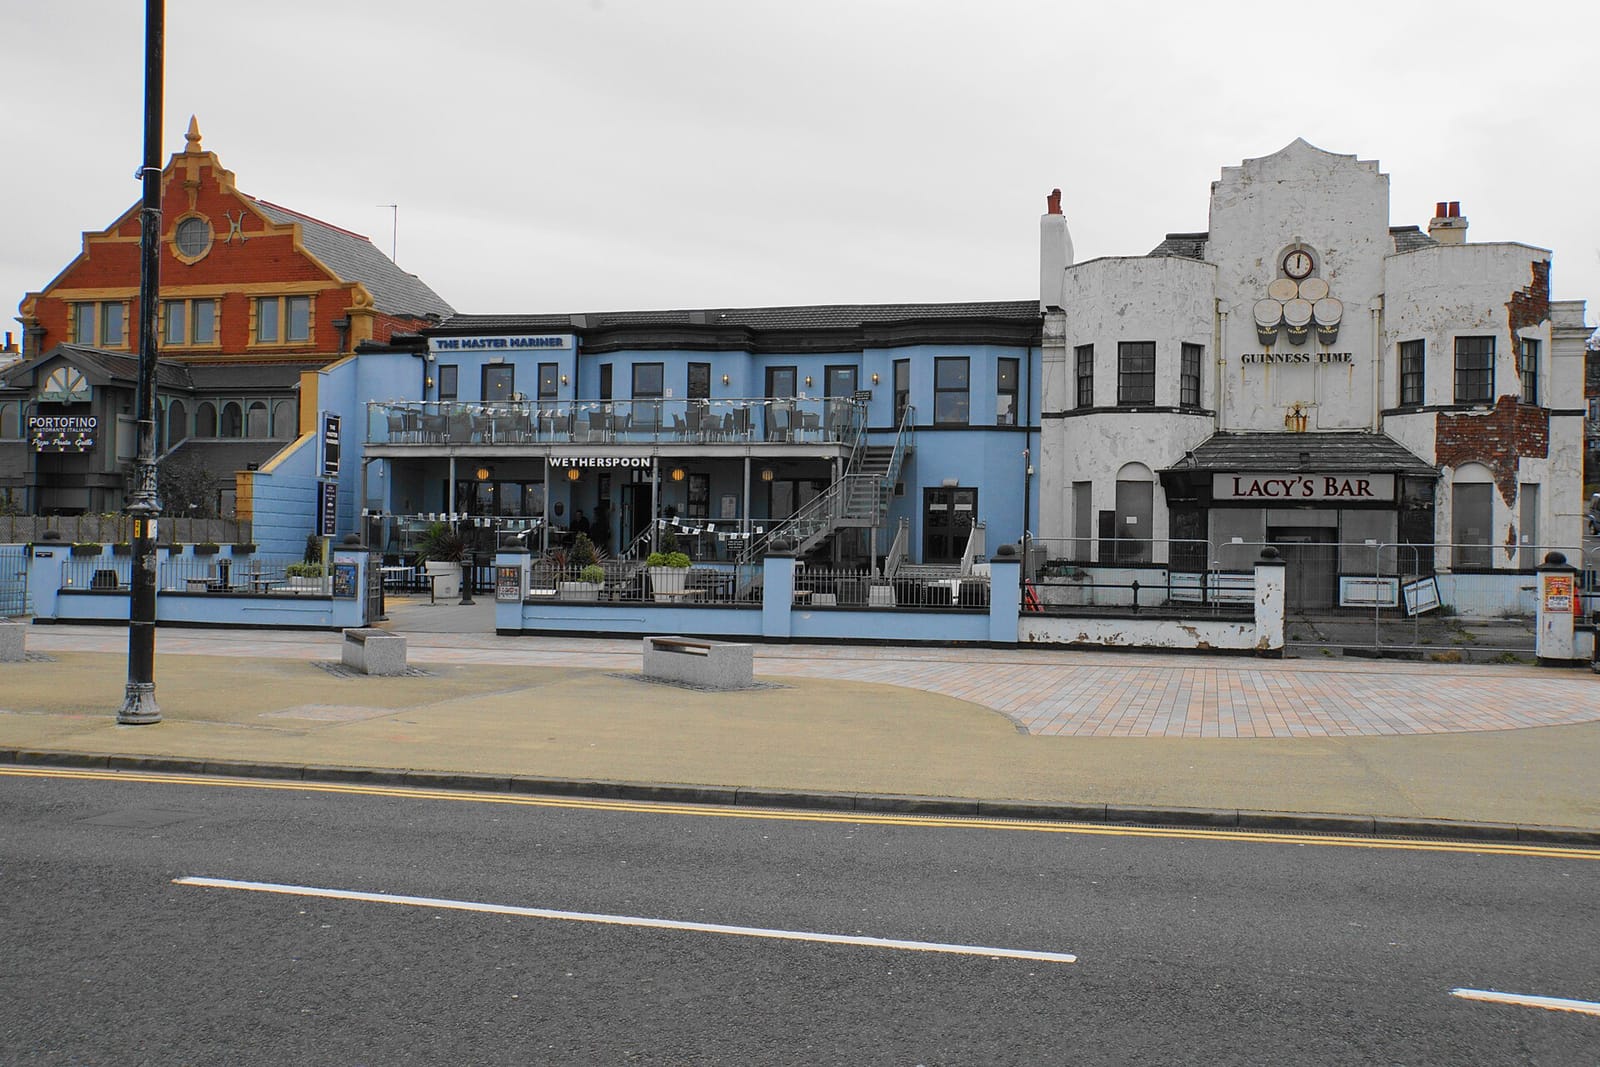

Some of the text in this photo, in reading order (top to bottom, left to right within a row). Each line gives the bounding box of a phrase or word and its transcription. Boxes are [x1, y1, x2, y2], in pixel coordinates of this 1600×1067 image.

[437, 337, 563, 349] THE MASTER MARINER
[1241, 353, 1352, 364] GUINNESS TIME
[29, 417, 97, 428] PORTOFINO
[549, 458, 650, 467] WETHERSPOON
[1232, 476, 1374, 497] LACY'S BAR
